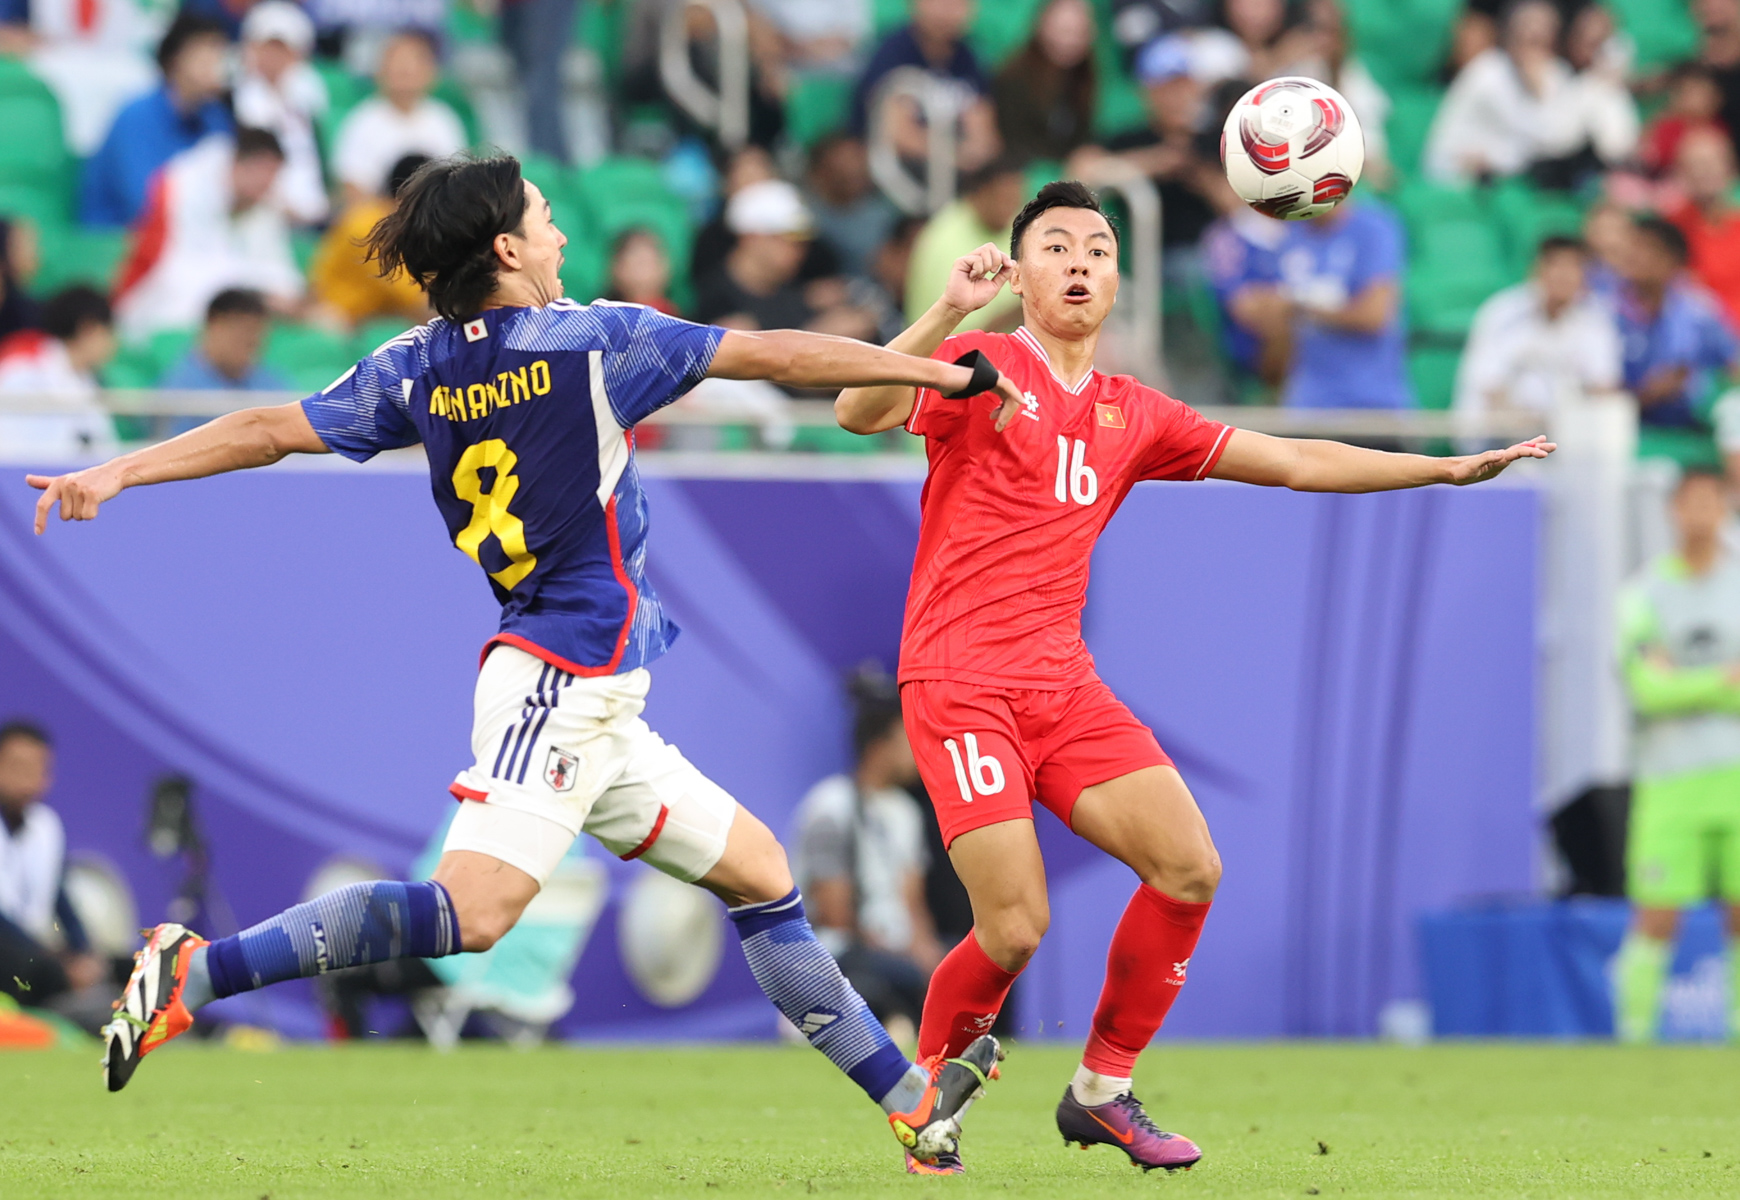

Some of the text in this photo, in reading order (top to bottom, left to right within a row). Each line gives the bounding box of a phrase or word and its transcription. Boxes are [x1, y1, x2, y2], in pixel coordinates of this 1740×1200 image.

[1054, 434, 1098, 506] 16
[452, 438, 537, 592] 8
[943, 732, 1006, 803] 16
